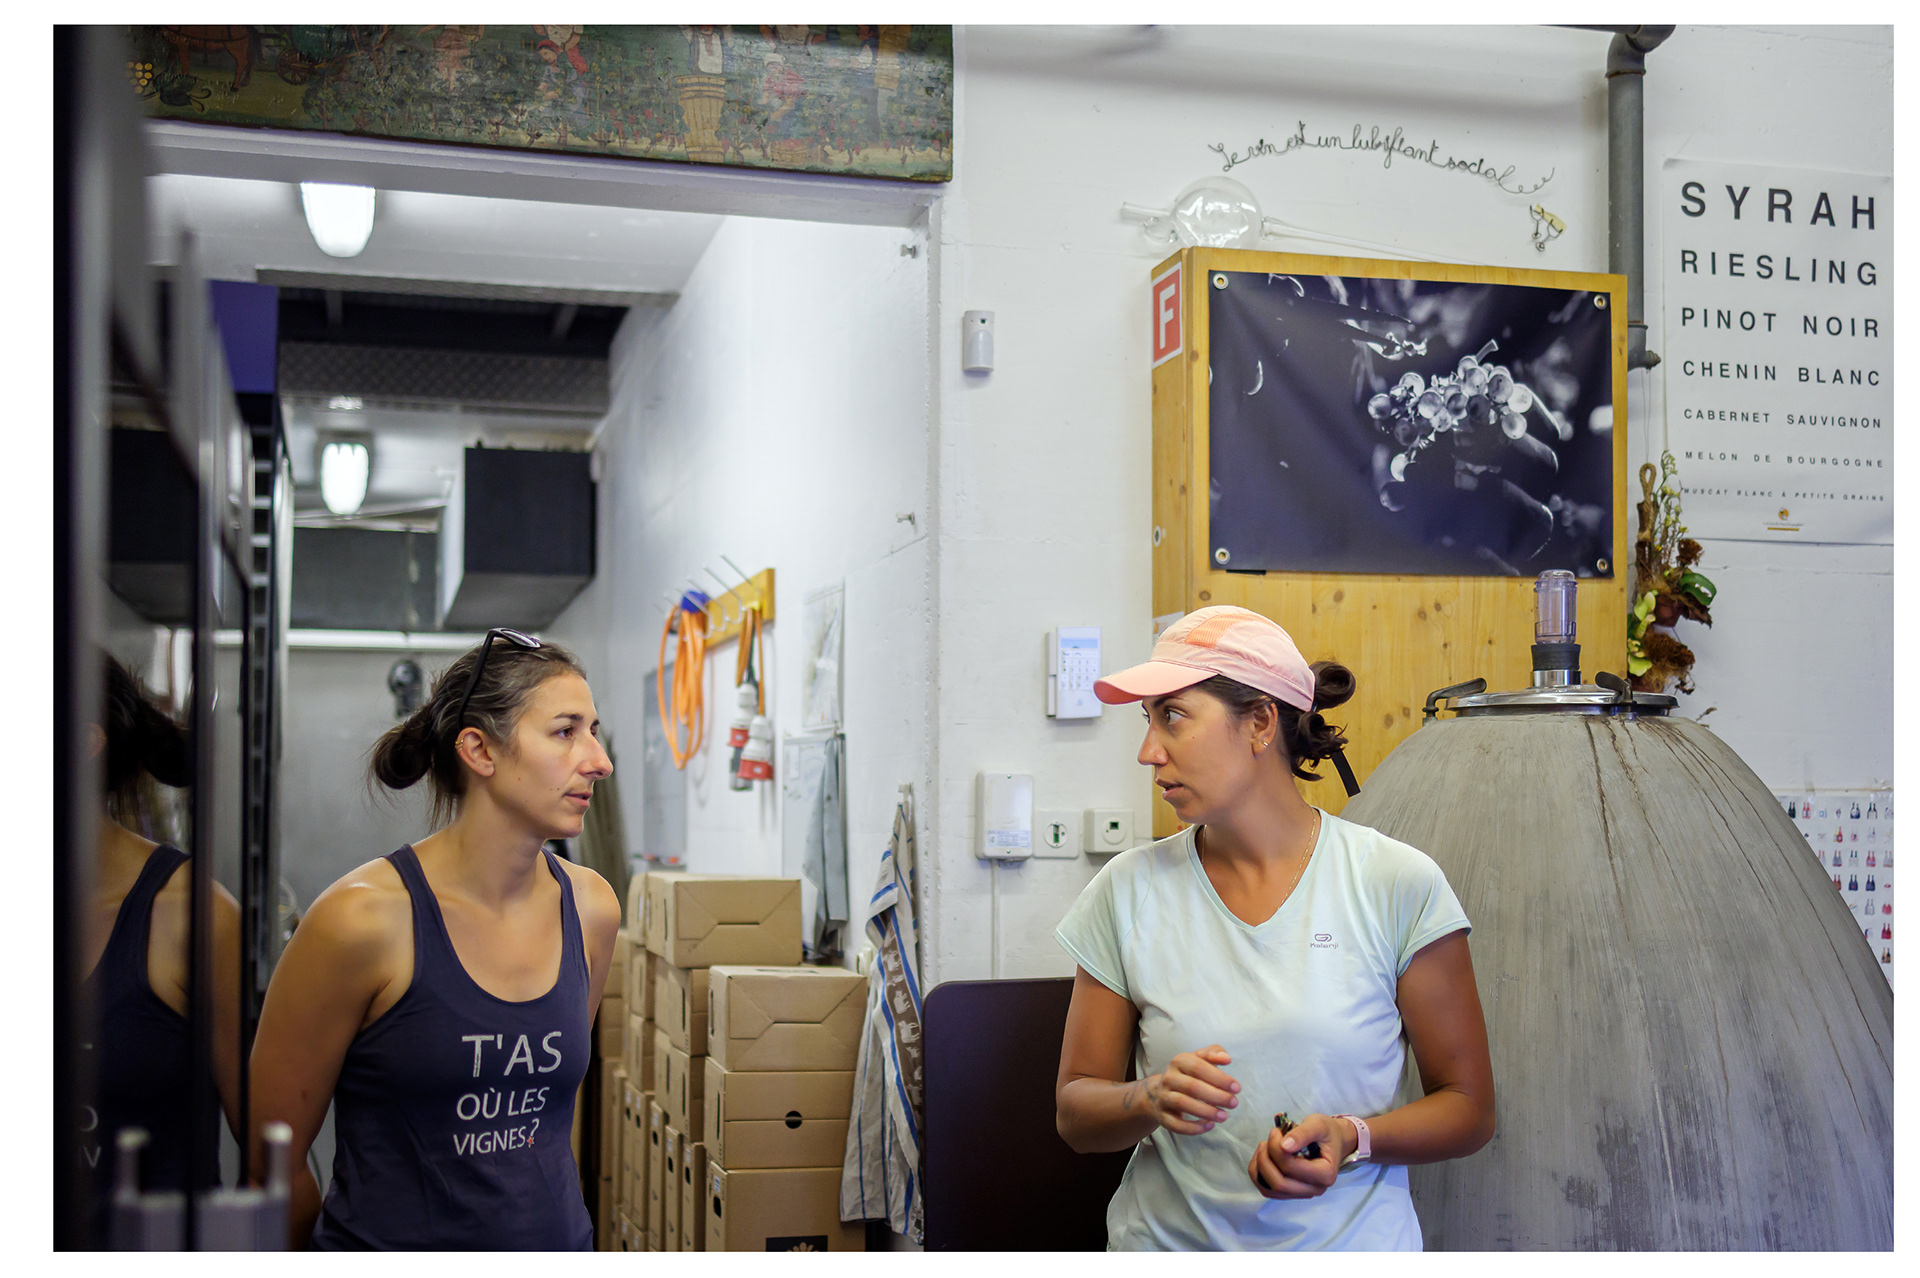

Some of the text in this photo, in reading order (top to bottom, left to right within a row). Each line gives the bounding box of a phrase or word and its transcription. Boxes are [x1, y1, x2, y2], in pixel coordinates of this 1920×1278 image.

[1317, 135, 1342, 148] un
[1681, 181, 1876, 230] SYRAH
[1681, 249, 1878, 286] RIESLING
[1159, 282, 1176, 350] F
[1681, 307, 1879, 338] PINOT NOIR
[1683, 360, 1880, 386] CHENIN BLANC
[1684, 409, 1881, 429] CABERNET SAUVIGNON
[1686, 451, 1883, 468] MELON DE BOURGOGNE
[1684, 488, 1728, 496] MUSCAT
[1737, 490, 1773, 498] BLANC
[461, 1031, 562, 1078] T'AS
[456, 1086, 550, 1120] OÙ LES
[453, 1118, 540, 1156] VIGNES?
